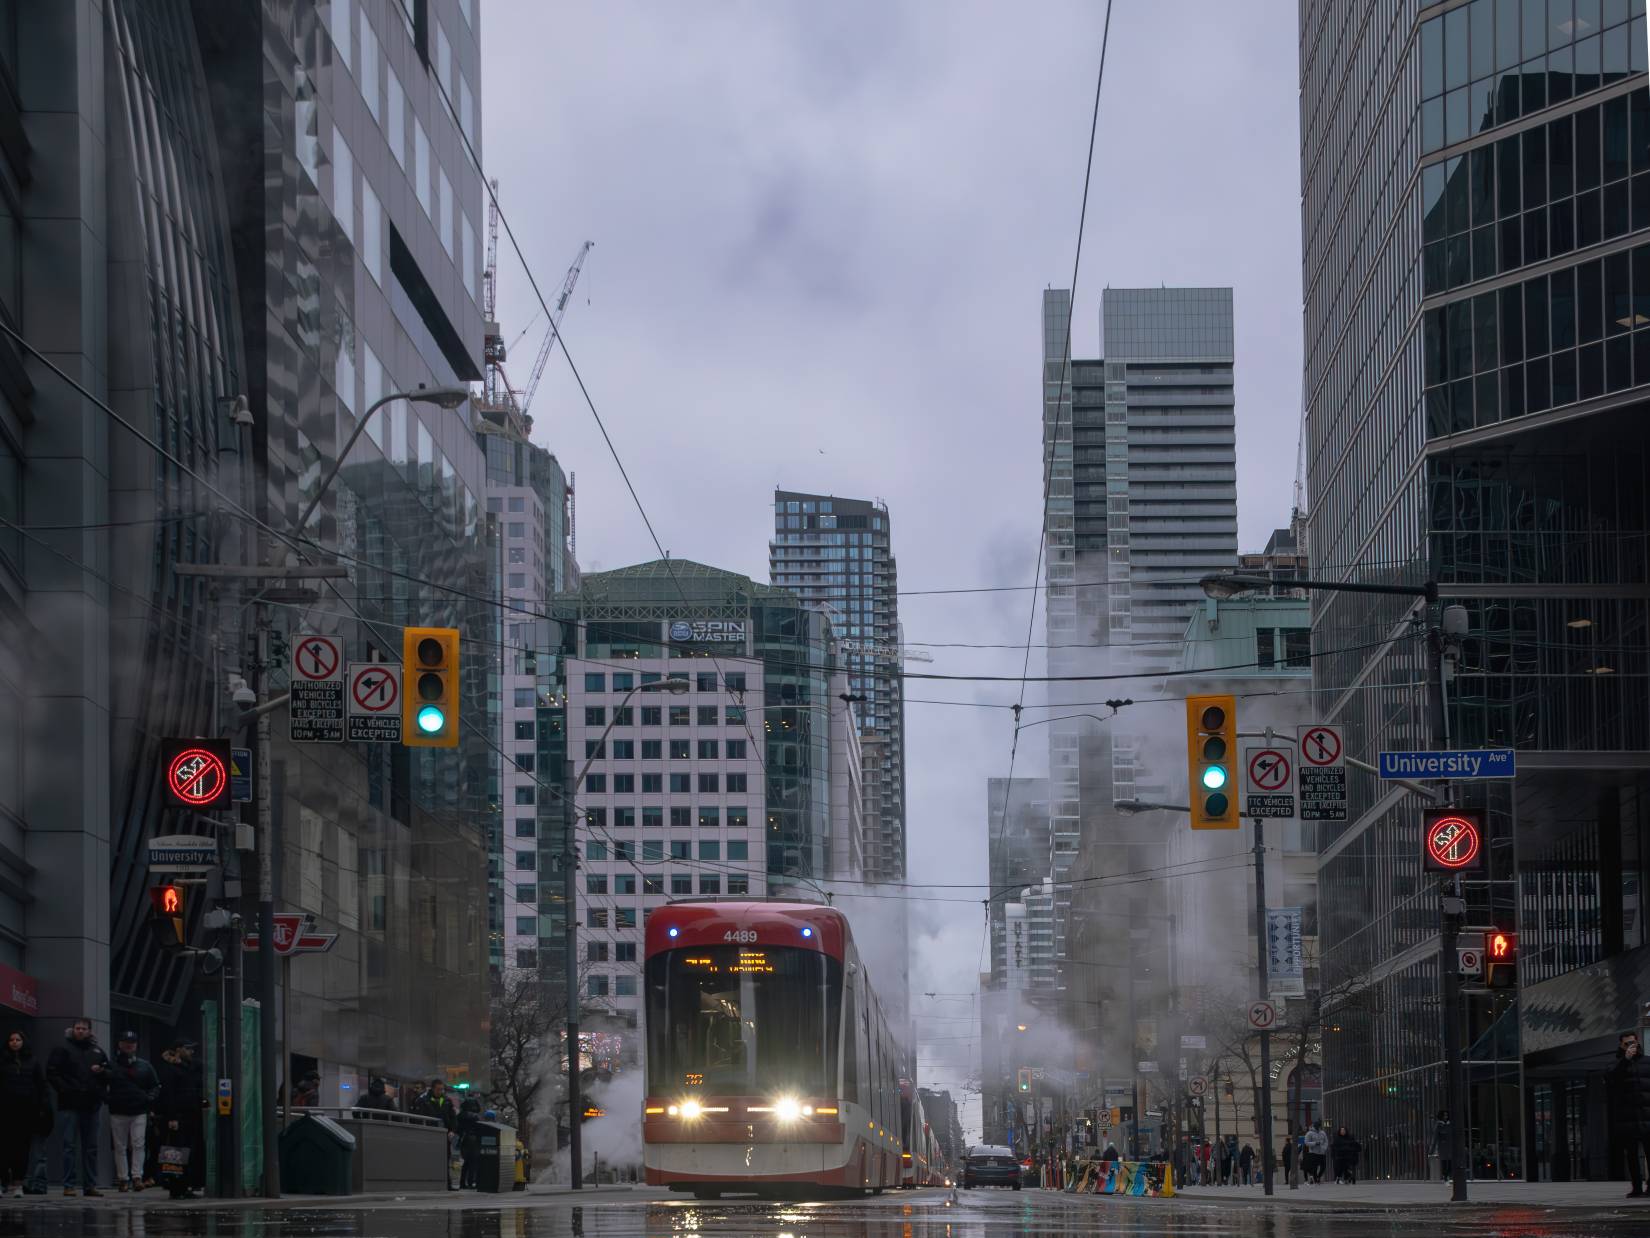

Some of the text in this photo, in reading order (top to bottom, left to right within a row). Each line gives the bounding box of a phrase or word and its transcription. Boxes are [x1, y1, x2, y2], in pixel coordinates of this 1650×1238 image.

[693, 621, 745, 632] SPIN
[693, 633, 745, 641] MASTER
[293, 681, 341, 690] AUTHORIZED
[299, 691, 336, 699] VEHICLES
[292, 700, 342, 709] AND BICYCLES
[297, 710, 337, 718] EXCEPTED
[313, 719, 343, 728] EXCEPTED
[350, 719, 400, 728] TTC VEHICLES
[352, 729, 397, 738] EXCEPTED
[1386, 752, 1507, 776] University Ave
[1316, 784, 1345, 792] BICYCLES
[1305, 792, 1341, 800] EXCEPTED
[1248, 798, 1294, 806] TTC VEHICLES
[1250, 807, 1291, 815] EXCEPTED
[151, 850, 203, 863] University
[723, 930, 758, 943] 4489
